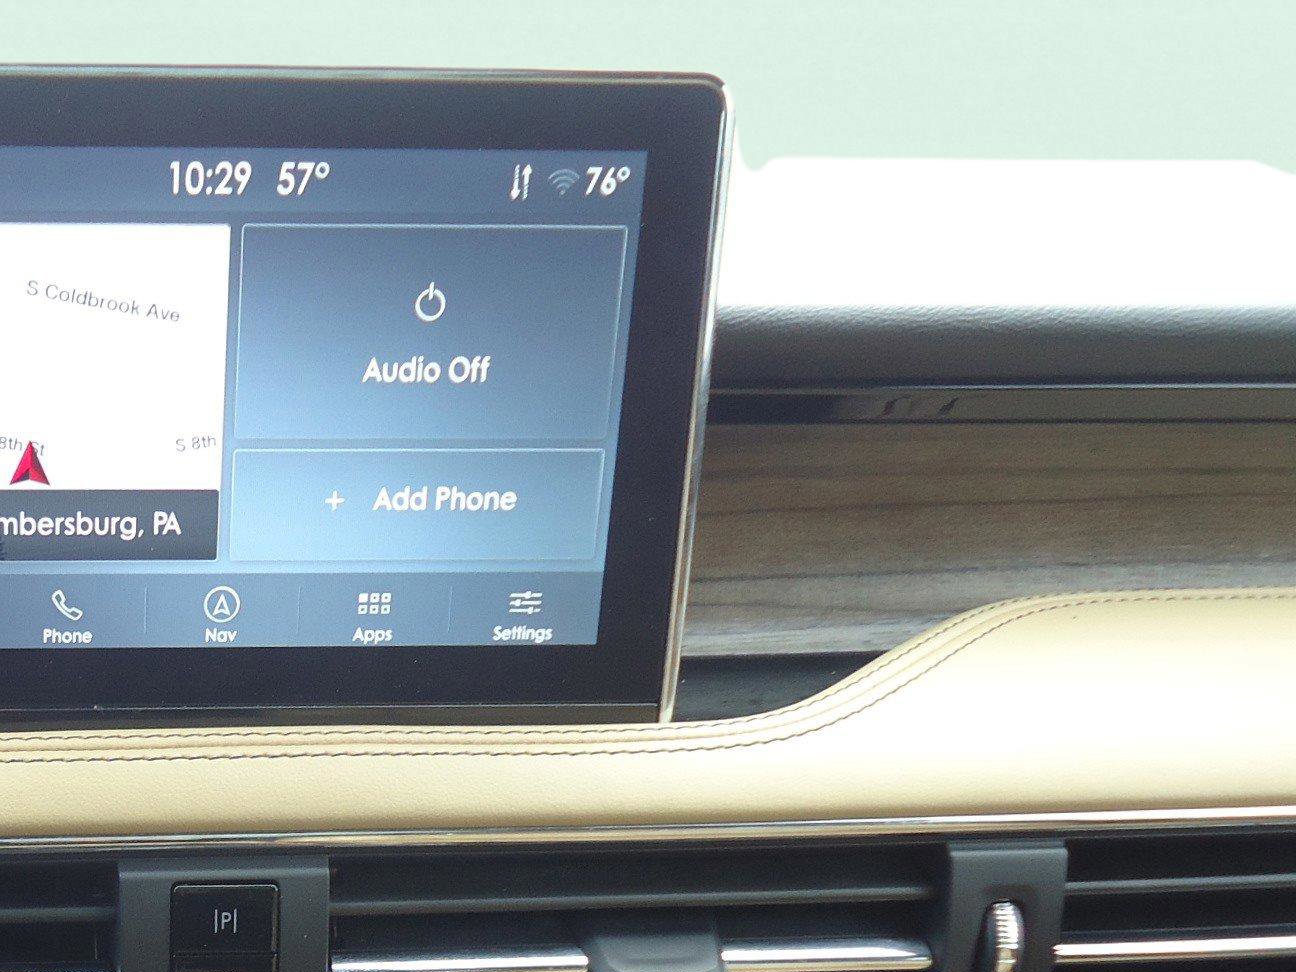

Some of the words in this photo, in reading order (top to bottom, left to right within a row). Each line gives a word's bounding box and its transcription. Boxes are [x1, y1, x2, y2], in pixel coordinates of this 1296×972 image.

[169, 160, 252, 195] 10:29
[27, 280, 39, 296] S
[45, 284, 141, 317] Coldbrook
[146, 303, 180, 322] Ave
[362, 355, 442, 384] Audio
[448, 355, 492, 384] Off
[175, 438, 186, 453] S
[191, 434, 217, 451] 8th
[372, 486, 428, 512] Add
[435, 486, 519, 512] Phone
[153, 510, 182, 537] PA
[43, 628, 93, 646] Phone
[204, 627, 239, 644] Nav
[353, 626, 394, 645] Apps
[493, 625, 554, 644] Settings
